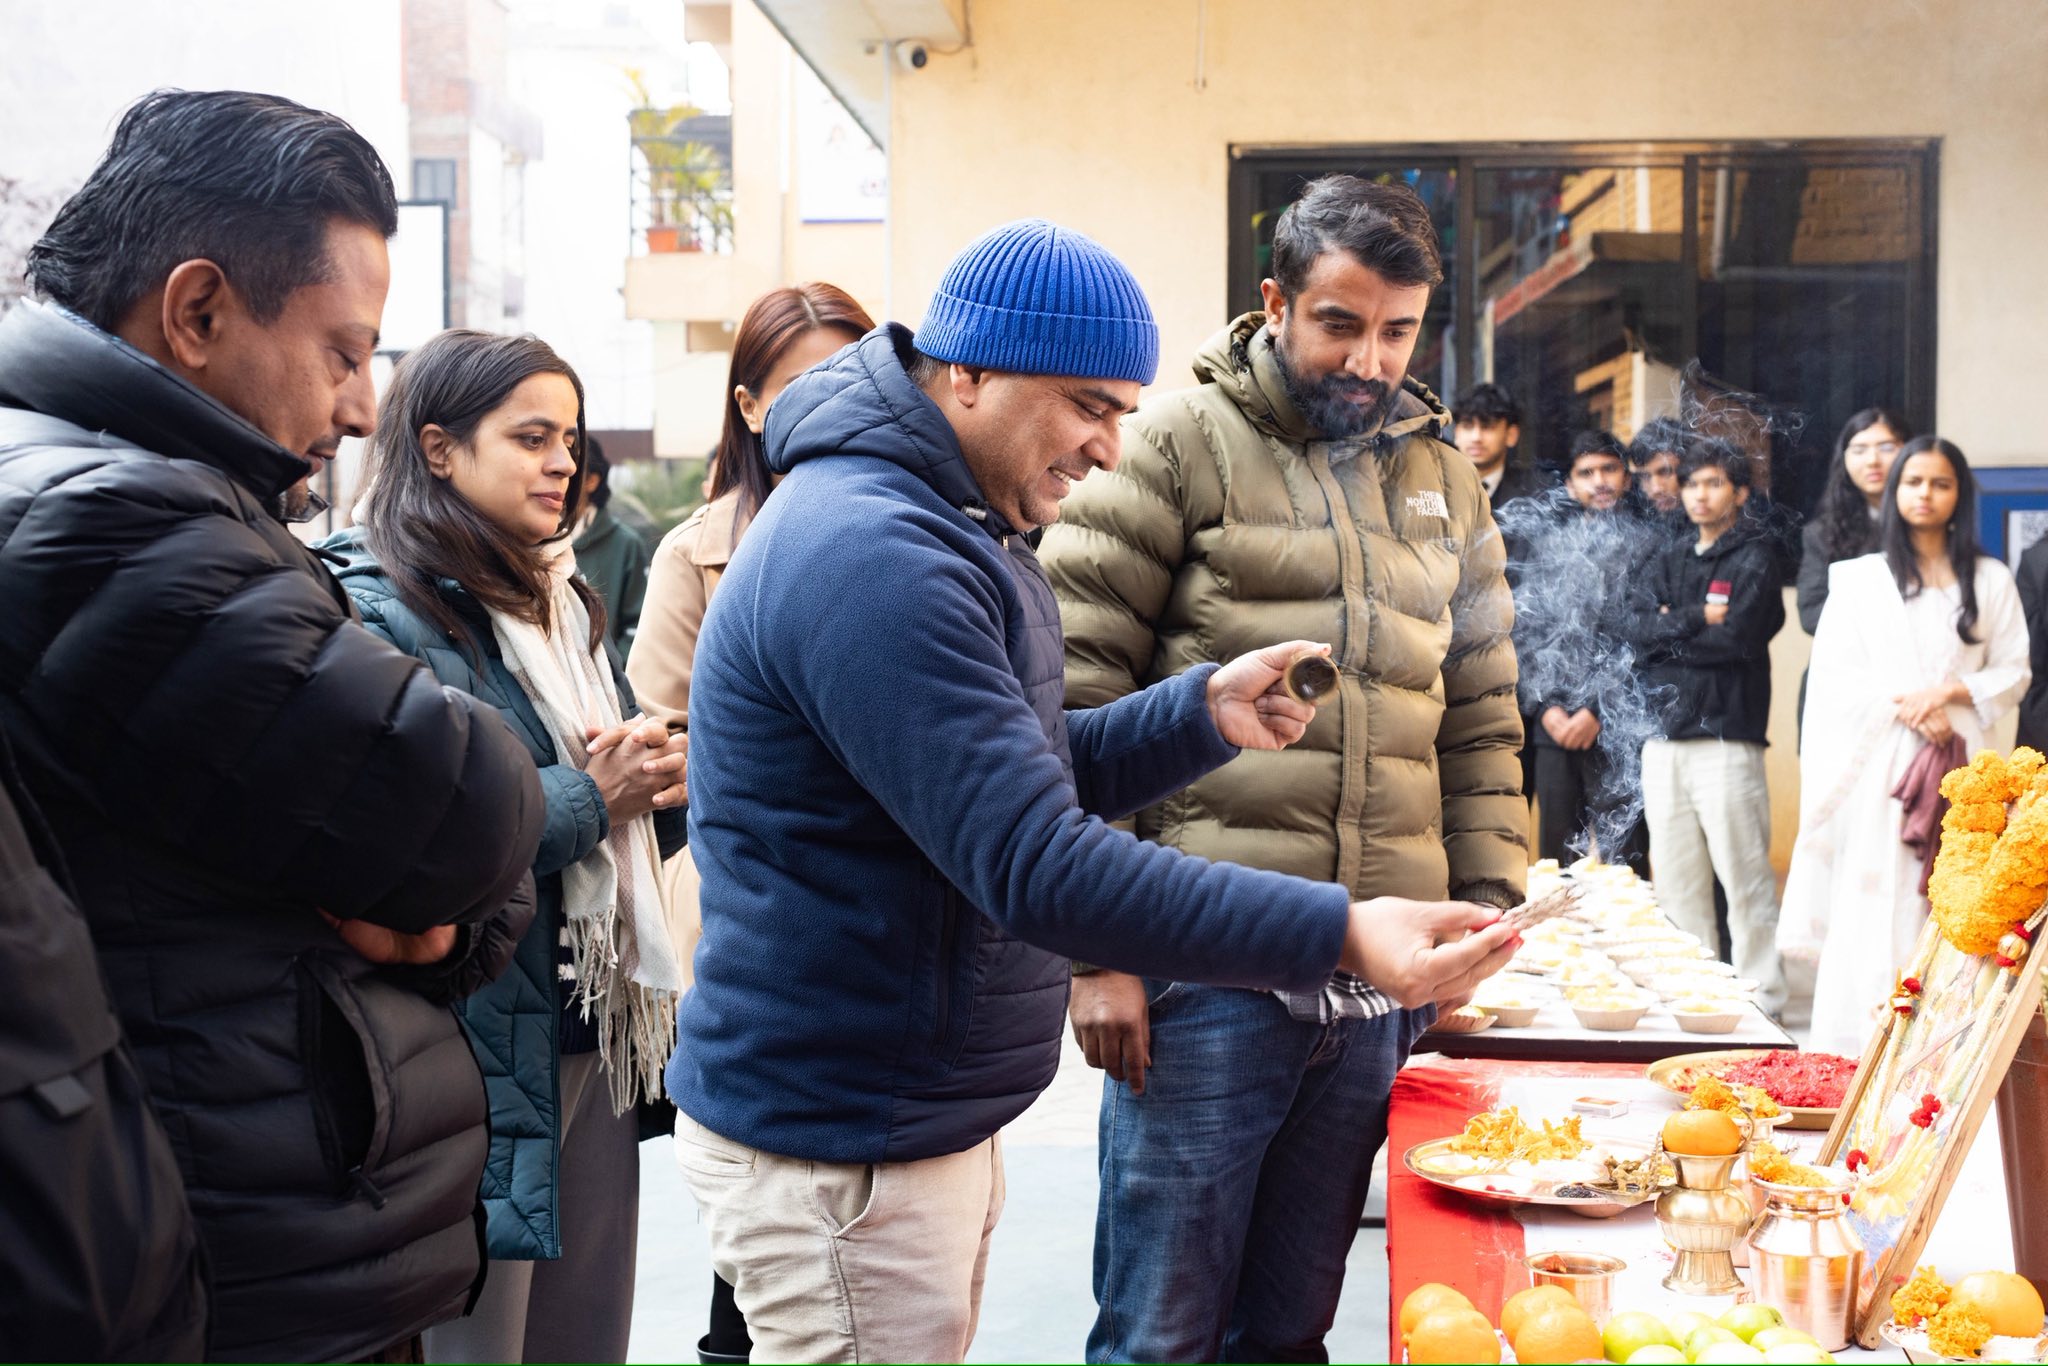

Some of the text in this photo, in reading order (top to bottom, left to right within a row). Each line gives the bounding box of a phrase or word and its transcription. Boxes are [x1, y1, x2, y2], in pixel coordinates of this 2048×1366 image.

[1417, 490, 1437, 499] THE
[1405, 496, 1438, 509] NORTH
[1416, 507, 1440, 517] FACE
